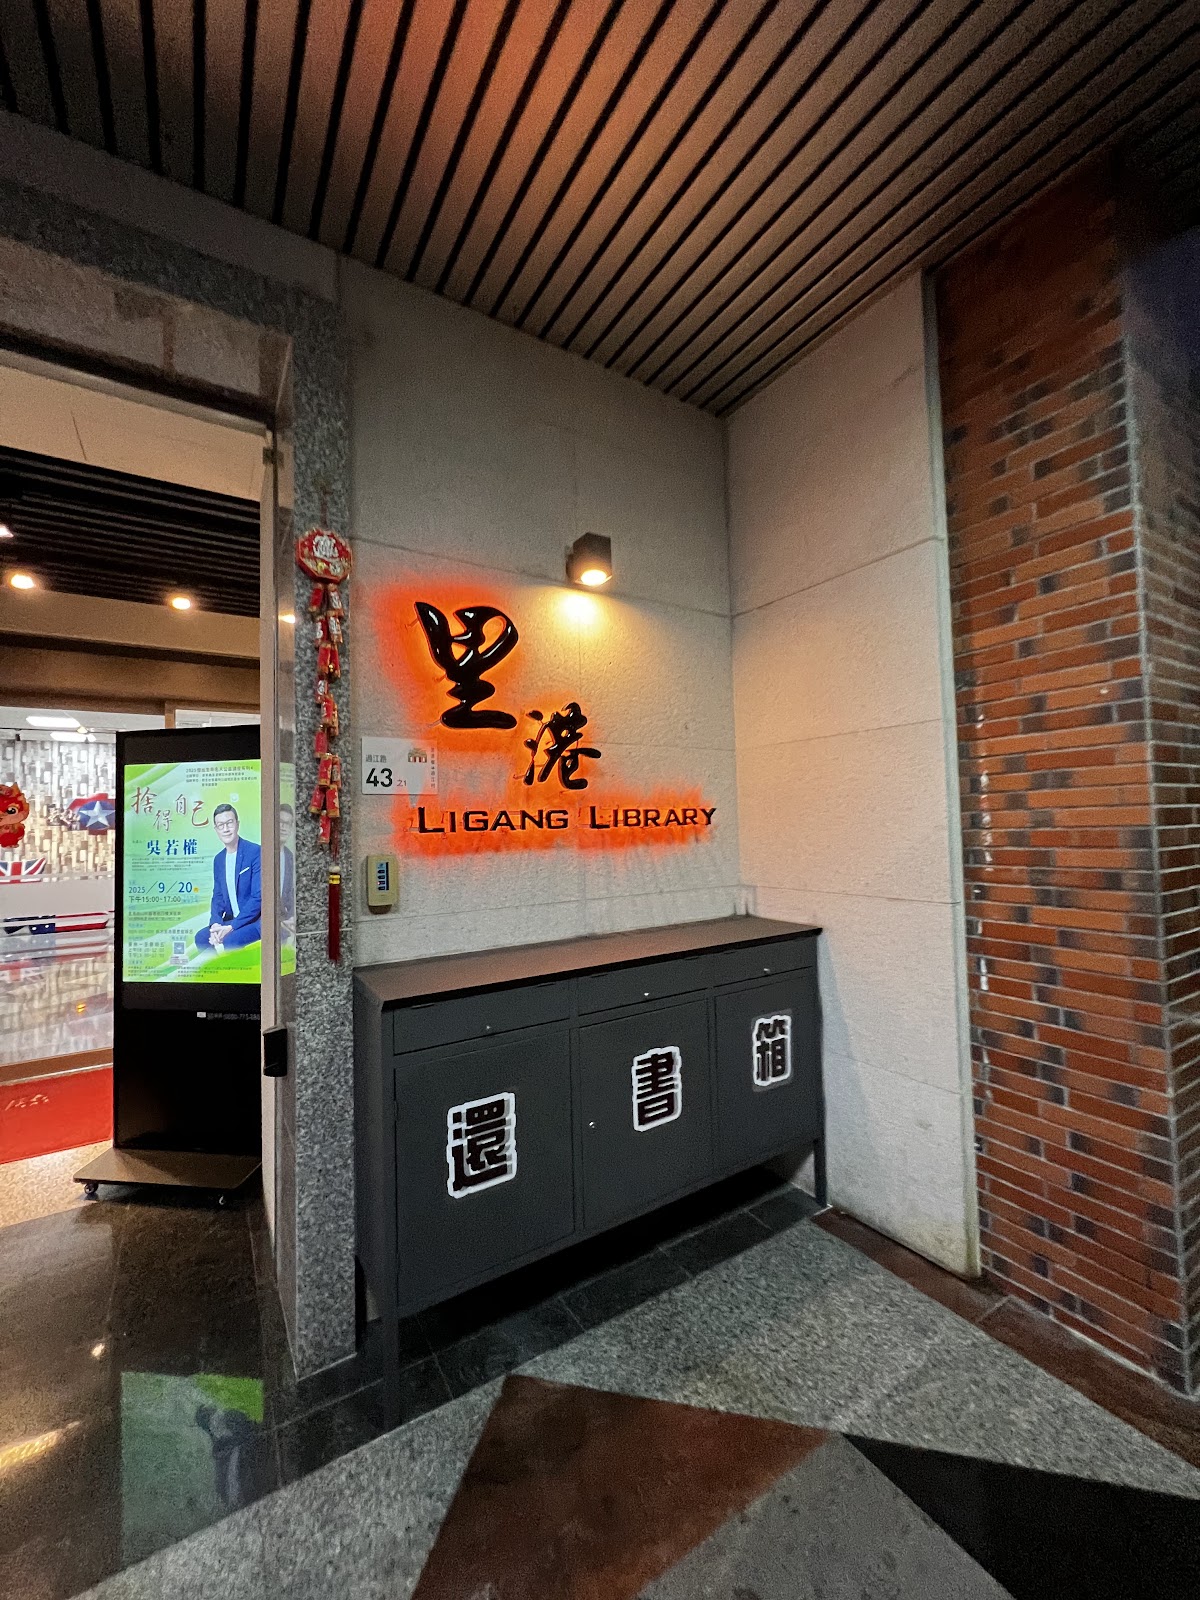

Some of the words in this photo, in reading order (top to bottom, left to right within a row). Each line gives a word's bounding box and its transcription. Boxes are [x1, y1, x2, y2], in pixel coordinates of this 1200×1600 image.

[414, 601, 602, 790] 里港
[365, 767, 393, 788] 43
[589, 805, 717, 829] LIBRARY
[147, 839, 198, 856] 吳若權
[448, 1092, 517, 1198] 還
[632, 1045, 682, 1132] 書
[752, 1014, 792, 1087] 箱
